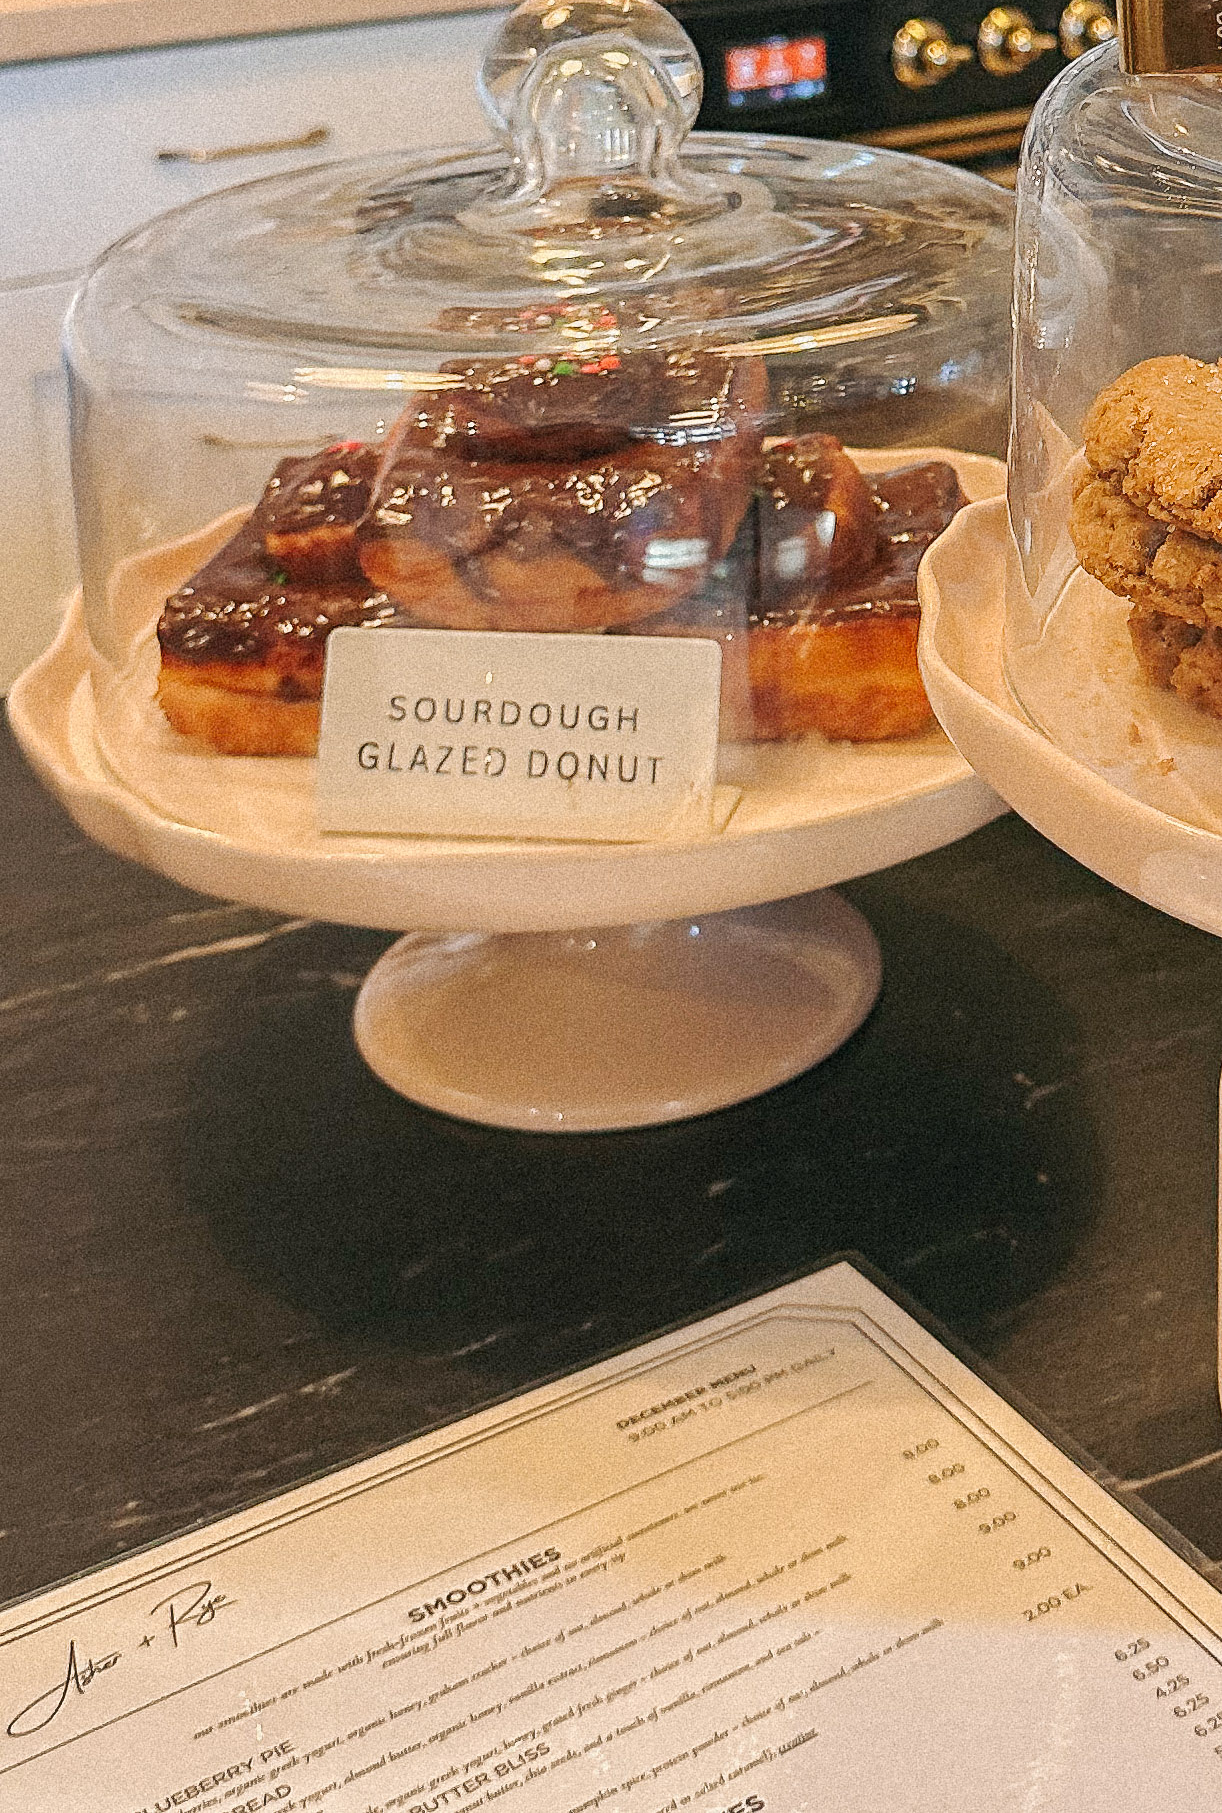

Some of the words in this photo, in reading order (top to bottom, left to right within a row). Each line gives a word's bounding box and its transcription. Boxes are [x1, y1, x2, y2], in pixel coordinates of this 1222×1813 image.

[387, 694, 640, 732] SOURDOUGH
[357, 740, 508, 777] GLAZED
[527, 748, 665, 784] DONUT
[616, 1387, 705, 1429] DECEMBER
[710, 1364, 756, 1388] MENU
[408, 1548, 560, 1622] SMOOTHIES
[1114, 1638, 1150, 1661] 6.25
[1132, 1656, 1169, 1681] 6.50
[1156, 1674, 1190, 1698] 4.25
[1173, 1693, 1209, 1718] 6.25
[260, 1740, 296, 1763] PIE
[494, 1743, 550, 1777] BLISS
[226, 1784, 292, 1813] READ
[569, 1787, 618, 1813] umpkin
